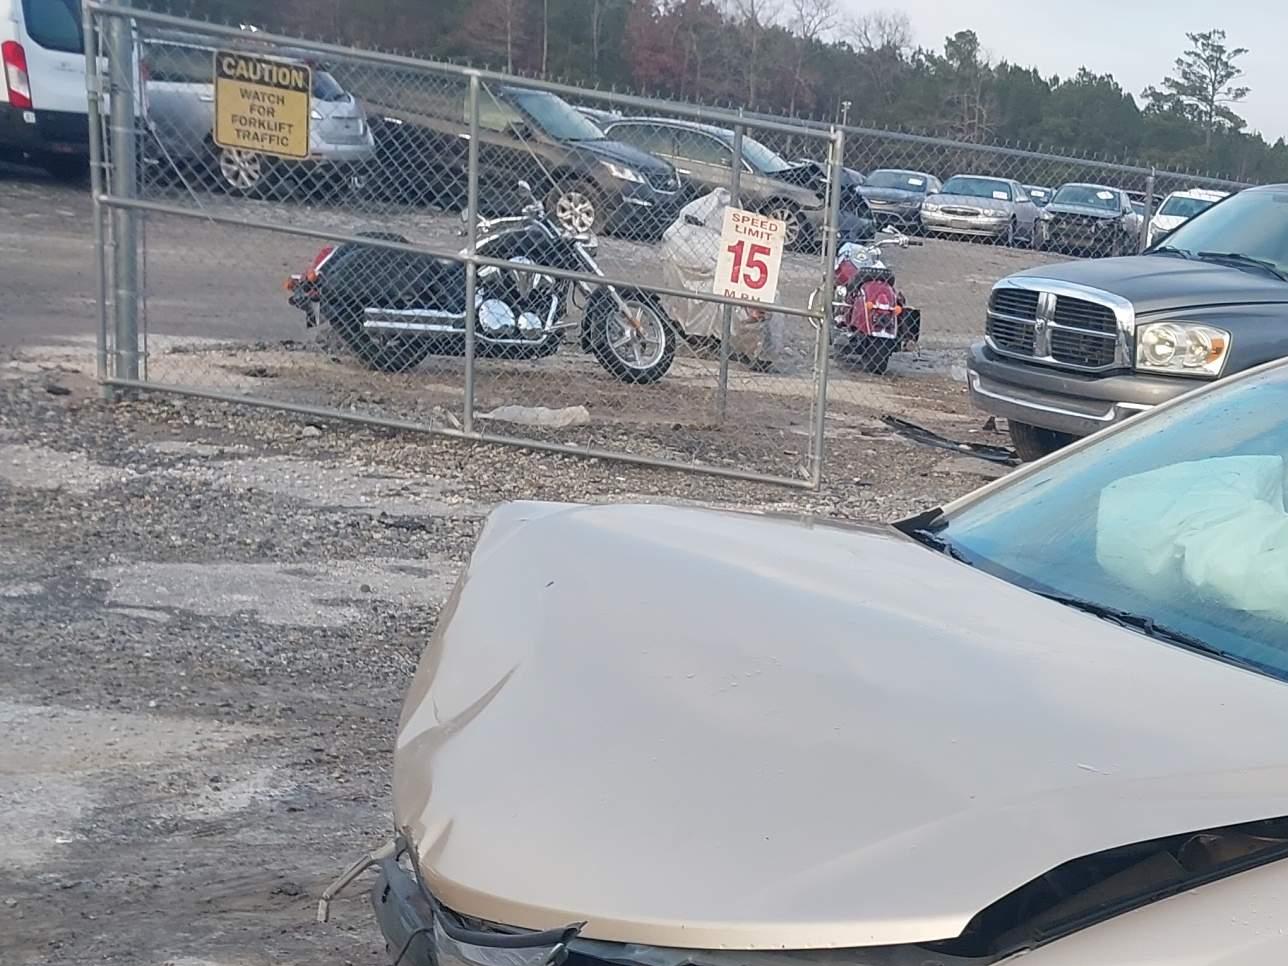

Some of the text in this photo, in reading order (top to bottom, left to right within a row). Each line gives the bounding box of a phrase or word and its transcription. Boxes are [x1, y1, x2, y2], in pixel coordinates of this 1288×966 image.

[222, 57, 304, 87] CAUTION
[239, 87, 285, 105] WATCH
[249, 103, 275, 118] FOR
[231, 114, 294, 135] FORKLIFT
[235, 128, 289, 147] TRAFFIC
[732, 212, 779, 233] SPEED
[735, 224, 773, 241] LIMIT
[727, 239, 771, 290] 15
